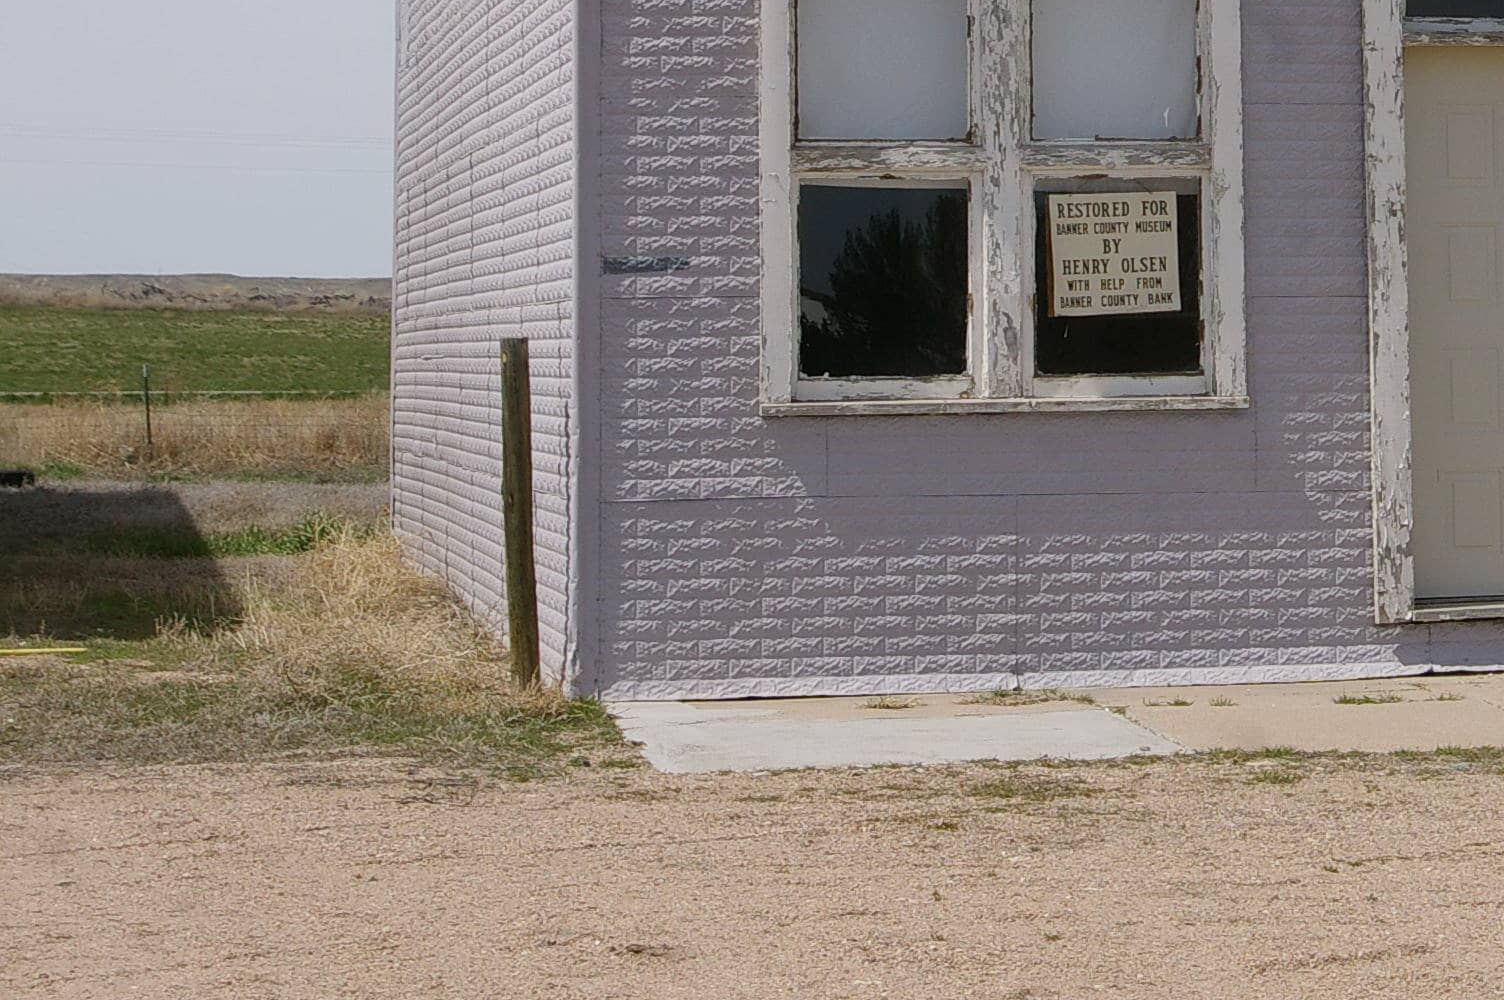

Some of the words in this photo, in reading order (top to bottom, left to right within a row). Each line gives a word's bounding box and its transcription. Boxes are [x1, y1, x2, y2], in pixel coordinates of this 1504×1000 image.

[1057, 202, 1130, 218] RESTORED
[1141, 200, 1169, 216] FOR
[1056, 223, 1089, 235] BANNER
[1094, 222, 1129, 234] COUNTY
[1136, 221, 1172, 233] MUSEUM
[1102, 238, 1121, 254] BY
[1062, 259, 1110, 275] HENRY
[1121, 256, 1167, 273] OLSEN
[1067, 280, 1090, 291] WITH
[1101, 278, 1125, 290] HELP
[1137, 277, 1163, 289] FROM
[1060, 296, 1092, 308] BANNER
[1101, 294, 1139, 306] COUNTY
[1148, 292, 1173, 304] BANK
